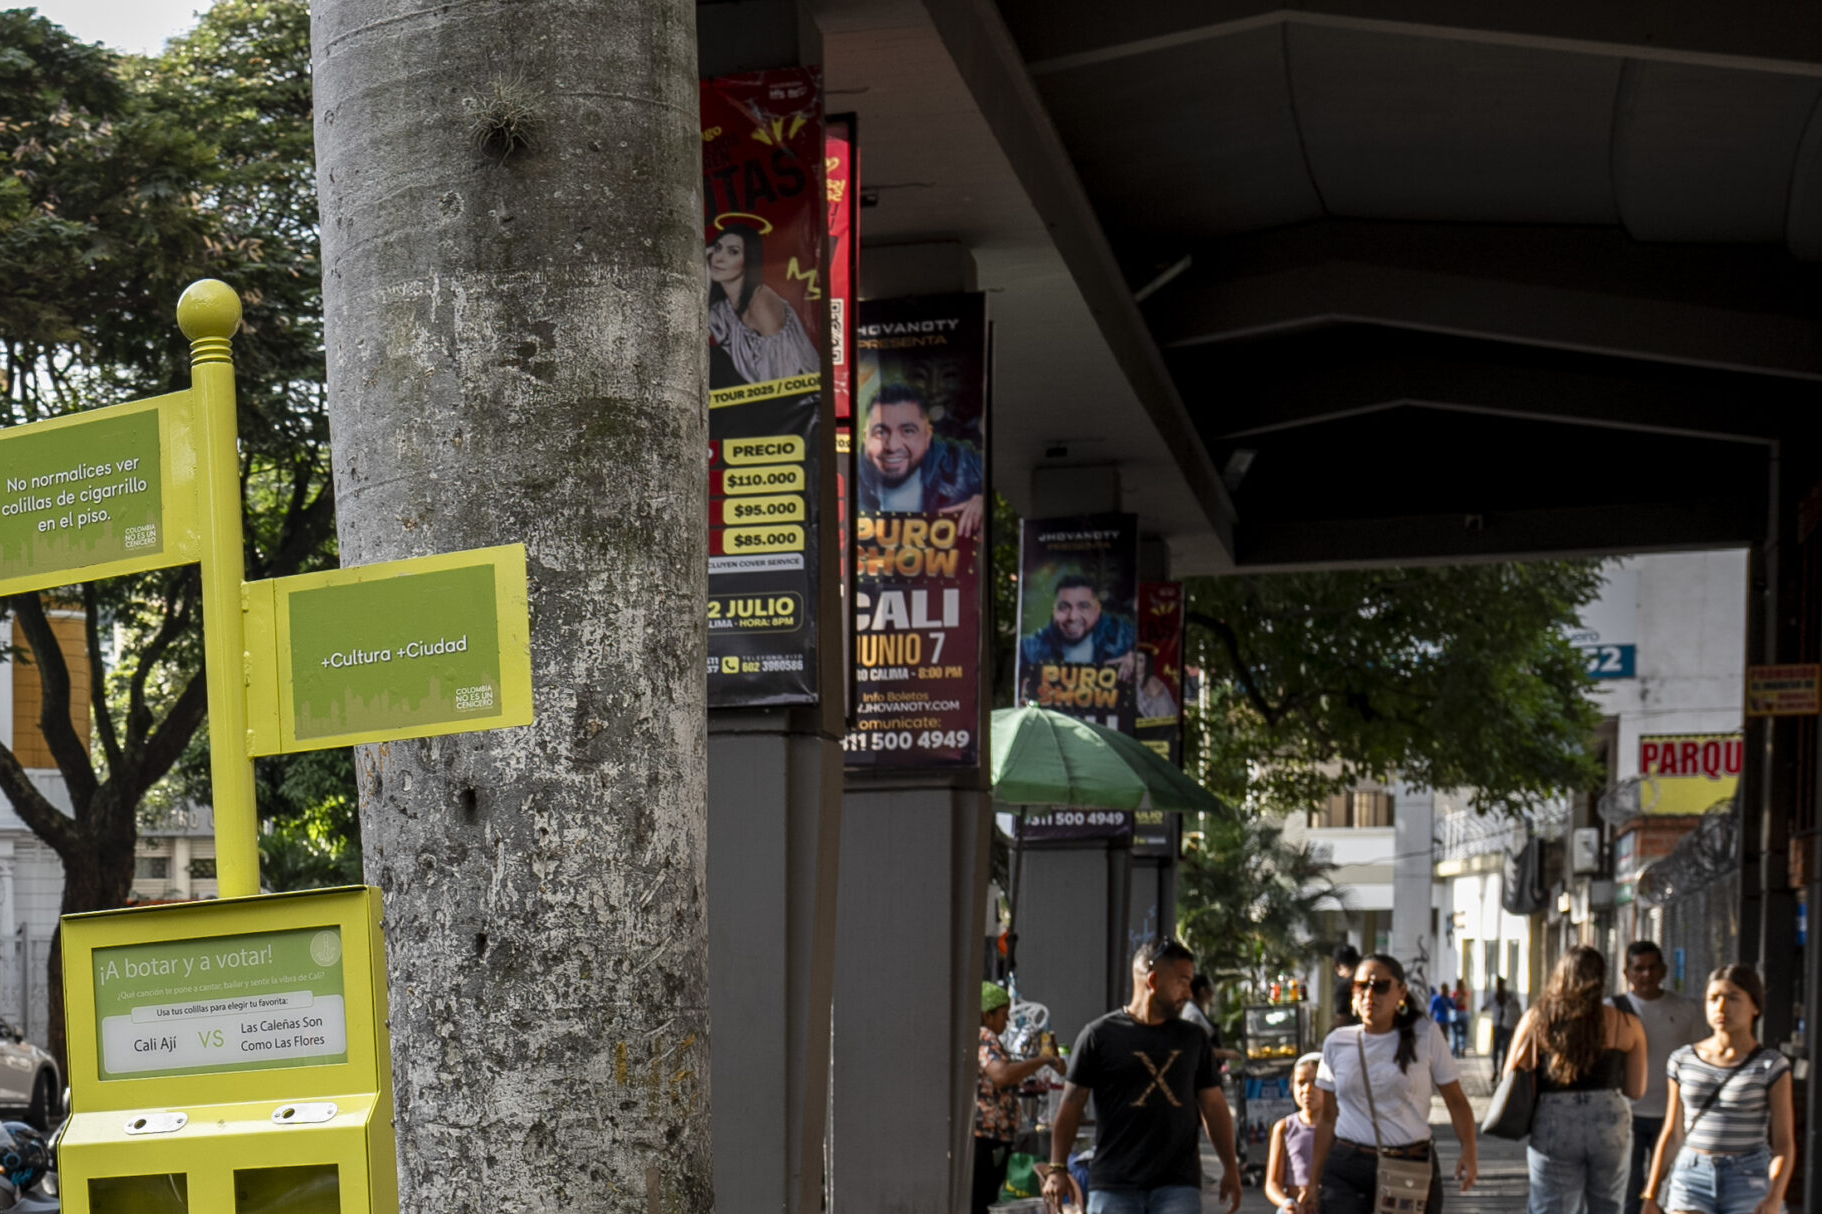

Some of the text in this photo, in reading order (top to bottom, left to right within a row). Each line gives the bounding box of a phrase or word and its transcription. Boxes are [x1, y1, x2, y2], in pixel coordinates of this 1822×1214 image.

[713, 388, 745, 403] TOUR
[747, 385, 774, 398] 2025
[733, 442, 795, 458] PRECIO
[7, 457, 139, 493] No normalices ver
[728, 471, 797, 489] $110.000
[2, 477, 148, 516] colillas de cigarrillo
[734, 502, 797, 519] $95.000
[38, 508, 111, 532] en el piso.
[125, 523, 156, 534] COLOMBIA
[125, 530, 156, 541] NO ES UN
[125, 537, 156, 548] CENICERO
[734, 532, 797, 548] $85.000
[739, 559, 765, 568] COVER
[768, 558, 800, 566] SERVICE
[726, 596, 795, 618] JULIO
[739, 618, 770, 628] HORA:
[772, 617, 794, 626] 8PM
[321, 635, 468, 669] +Cultura +Ciudad
[857, 632, 945, 667] UNIO 7
[870, 668, 909, 681] CALIMA
[918, 666, 943, 679] 8:00
[945, 666, 962, 678] PM
[1042, 664, 1117, 689] PURO
[456, 684, 493, 695] COLOMBIA
[456, 691, 493, 703] NO ES UN
[863, 690, 929, 703] Info Boletos
[1037, 683, 1119, 709] SHOW
[456, 699, 493, 710] CENICERO
[858, 715, 942, 731] omunicate:
[871, 731, 913, 750] 500
[917, 730, 970, 749] 4949
[1055, 812, 1085, 825] 500
[1087, 812, 1125, 825] 4949
[99, 944, 273, 986] ¡A botar y a votar!
[117, 989, 135, 1001] ¿Qué
[136, 987, 164, 999] canción
[165, 987, 173, 996] te
[174, 985, 192, 996] pone
[199, 982, 223, 993] cantar,
[223, 979, 243, 990] bailar
[250, 977, 270, 987] sentir
[271, 976, 278, 985] la
[279, 973, 297, 984] vibra
[298, 972, 307, 982] de
[308, 970, 325, 981] Cali?
[156, 997, 288, 1017] Usa tus colillas para elegir tu favorita:
[241, 1016, 323, 1034] Las Caleñas Son
[134, 1029, 224, 1054] Cali Ají VS
[241, 1034, 325, 1052] Como Las Flores
[1130, 1048, 1183, 1107] X
